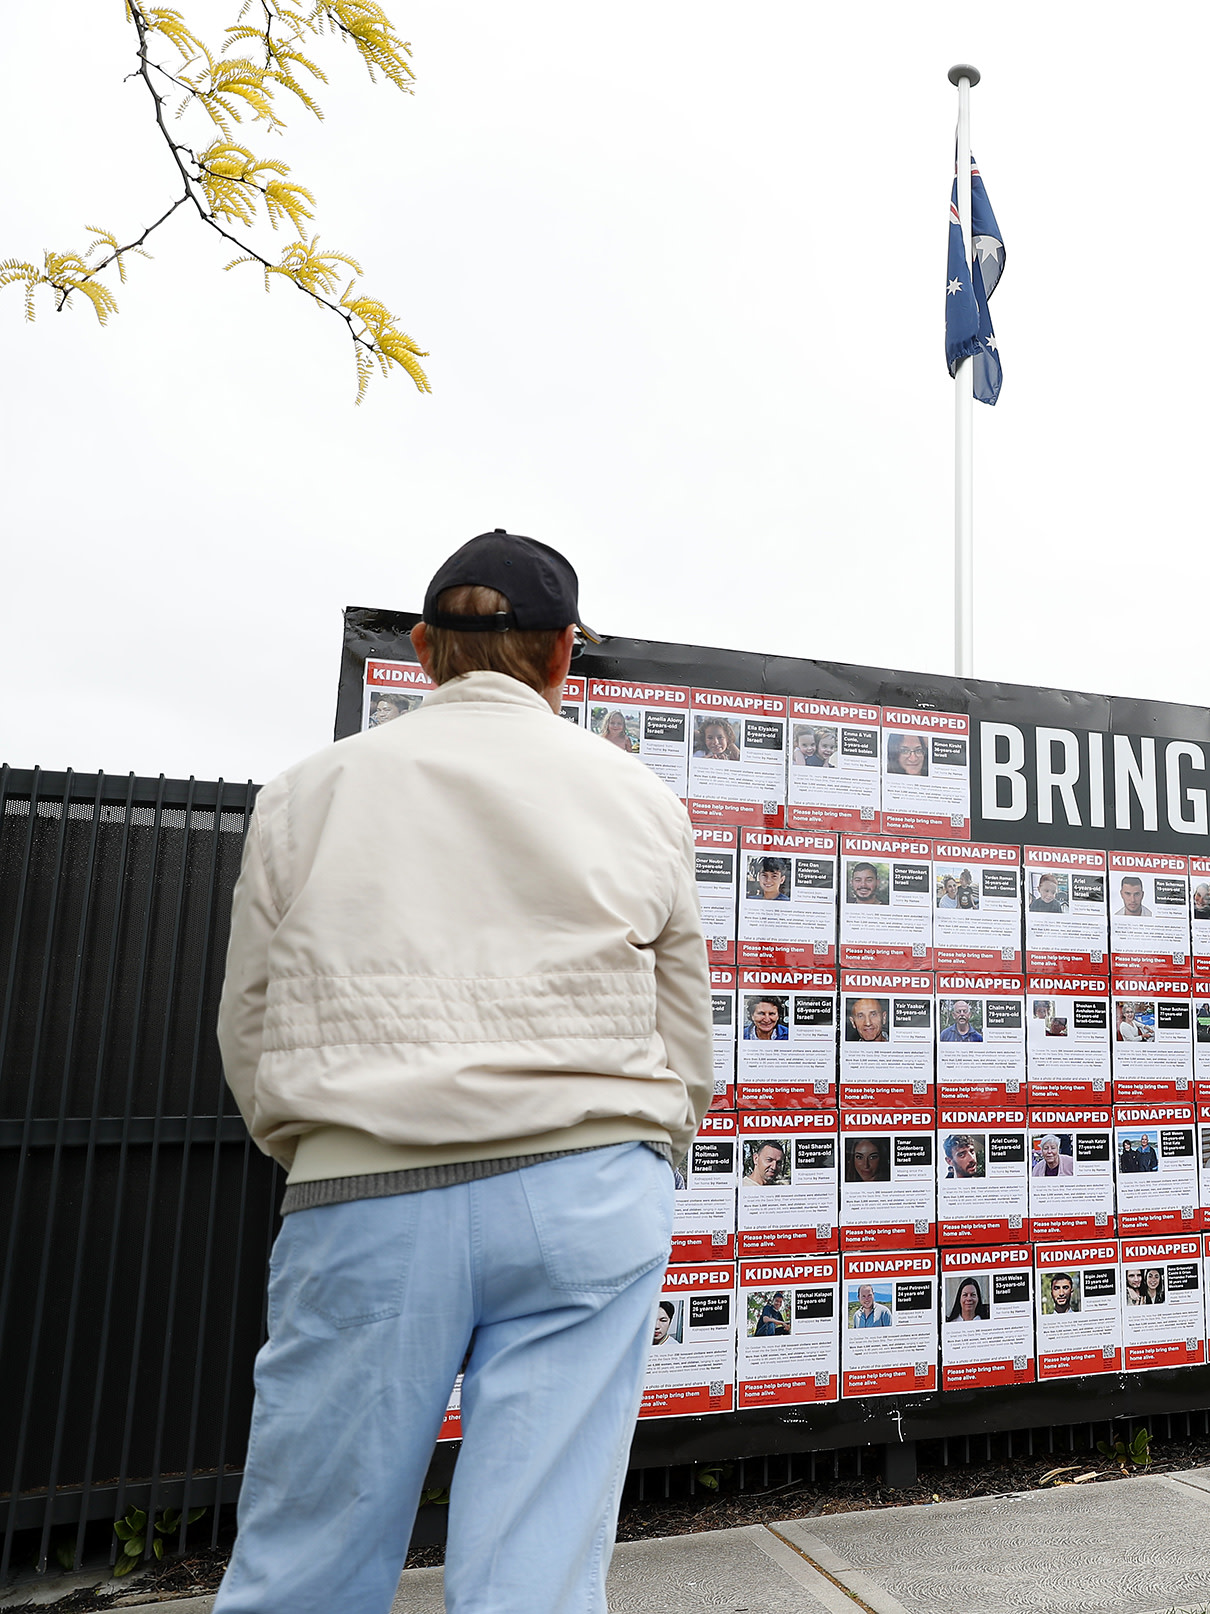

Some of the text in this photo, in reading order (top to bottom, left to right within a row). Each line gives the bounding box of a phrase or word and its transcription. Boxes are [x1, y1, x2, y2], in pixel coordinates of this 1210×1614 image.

[592, 684, 686, 703] KIDNAPPED
[695, 692, 784, 712] KIDNAPPED
[793, 702, 878, 721] KIDNAPPED
[886, 711, 967, 731] KIDNAPPED
[980, 722, 1208, 835] BRING
[745, 832, 835, 850] KIDNAPPED
[845, 838, 929, 855] KIDNAPPED
[936, 844, 1017, 861] KIDNAPPED
[1028, 850, 1103, 867] KIDNAPPED
[1112, 855, 1185, 870] KIDNAPPED
[743, 971, 833, 985] KIDNAPPED
[845, 974, 931, 988] KIDNAPPED
[939, 976, 1021, 990] KIDNAPPED
[1029, 978, 1106, 991] KIDNAPPED
[1115, 979, 1189, 993] KIDNAPPED
[743, 1114, 835, 1128] KIDNAPPED
[844, 1113, 932, 1126] KIDNAPPED
[941, 1111, 1024, 1123] KIDNAPPED
[1031, 1111, 1109, 1123] KIDNAPPED
[798, 1150, 832, 1158] 52-years-old
[695, 1158, 730, 1166] 77-years-old
[1125, 1242, 1197, 1257] KIDNAPPED
[945, 1249, 1029, 1266] KIDNAPPED
[745, 1265, 833, 1281] KIDNAPPED
[848, 1258, 932, 1273] KIDNAPPED
[995, 1281, 1026, 1289] 53-years-old
